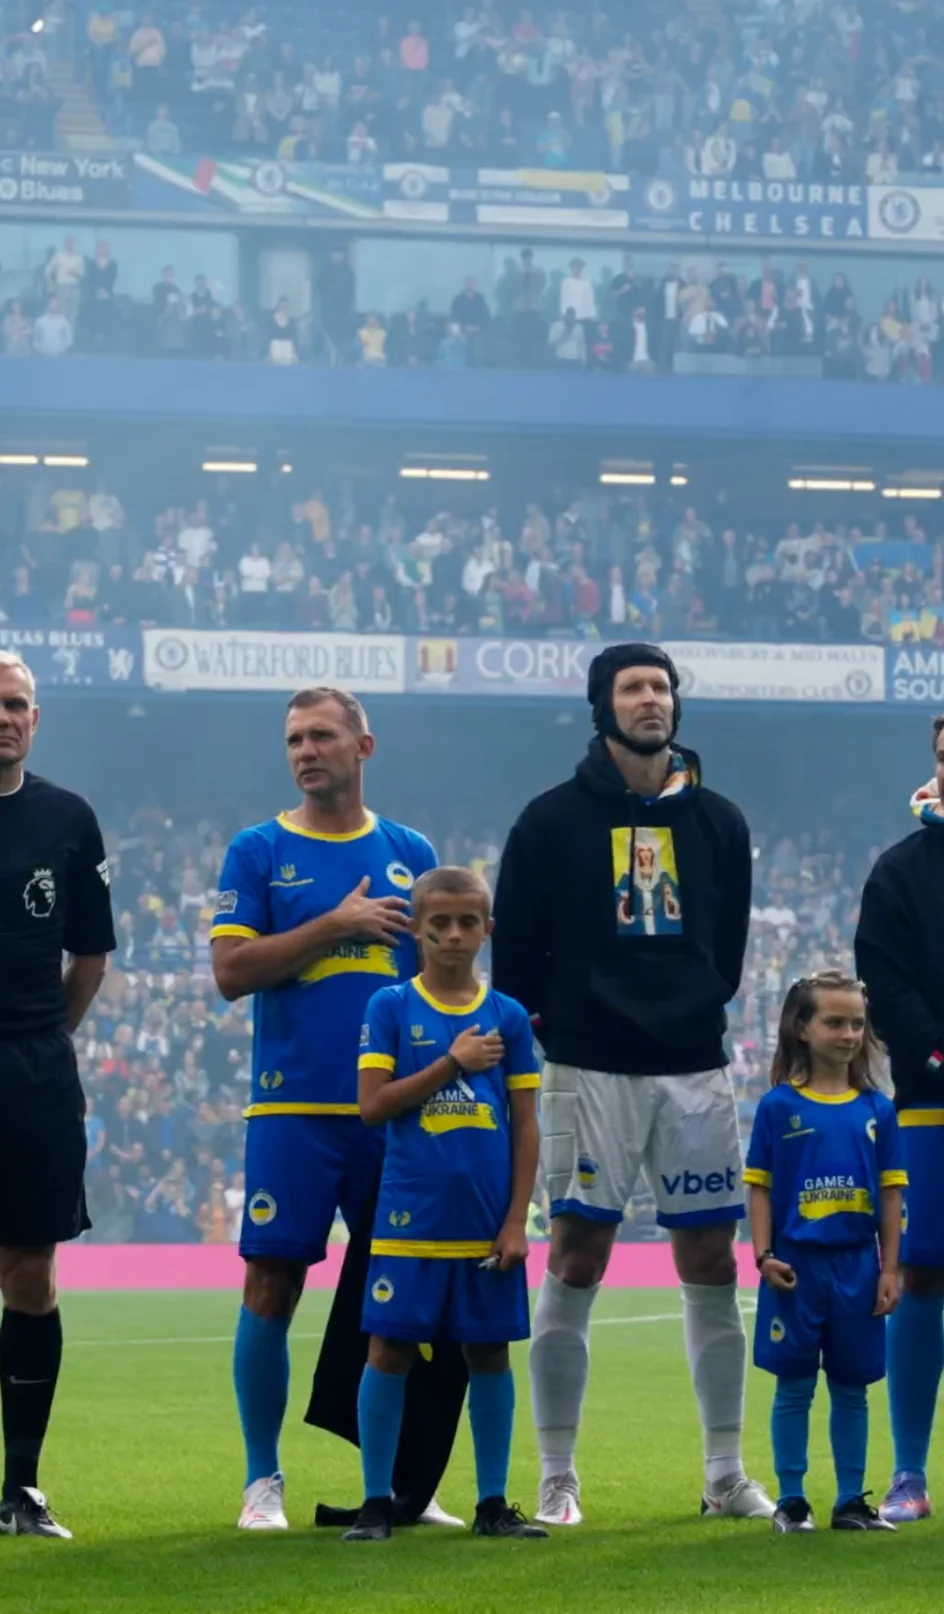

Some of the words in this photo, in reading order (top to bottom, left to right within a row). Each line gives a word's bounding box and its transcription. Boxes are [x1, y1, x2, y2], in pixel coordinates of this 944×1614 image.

[20, 155, 68, 177] New
[74, 157, 125, 179] York
[20, 179, 84, 202] Blues
[689, 179, 863, 206] MELBOURNE
[688, 211, 864, 237] CHELSEA
[48, 631, 104, 648] BLUES
[193, 636, 328, 680] WATERFORD
[336, 645, 397, 682] BLUES
[476, 640, 588, 680] CORK
[427, 1089, 475, 1103] AME
[425, 1103, 479, 1117] UKRAINE
[661, 1167, 735, 1195] vbet
[804, 1175, 855, 1190] GAME4
[804, 1189, 857, 1204] UKRAINE
